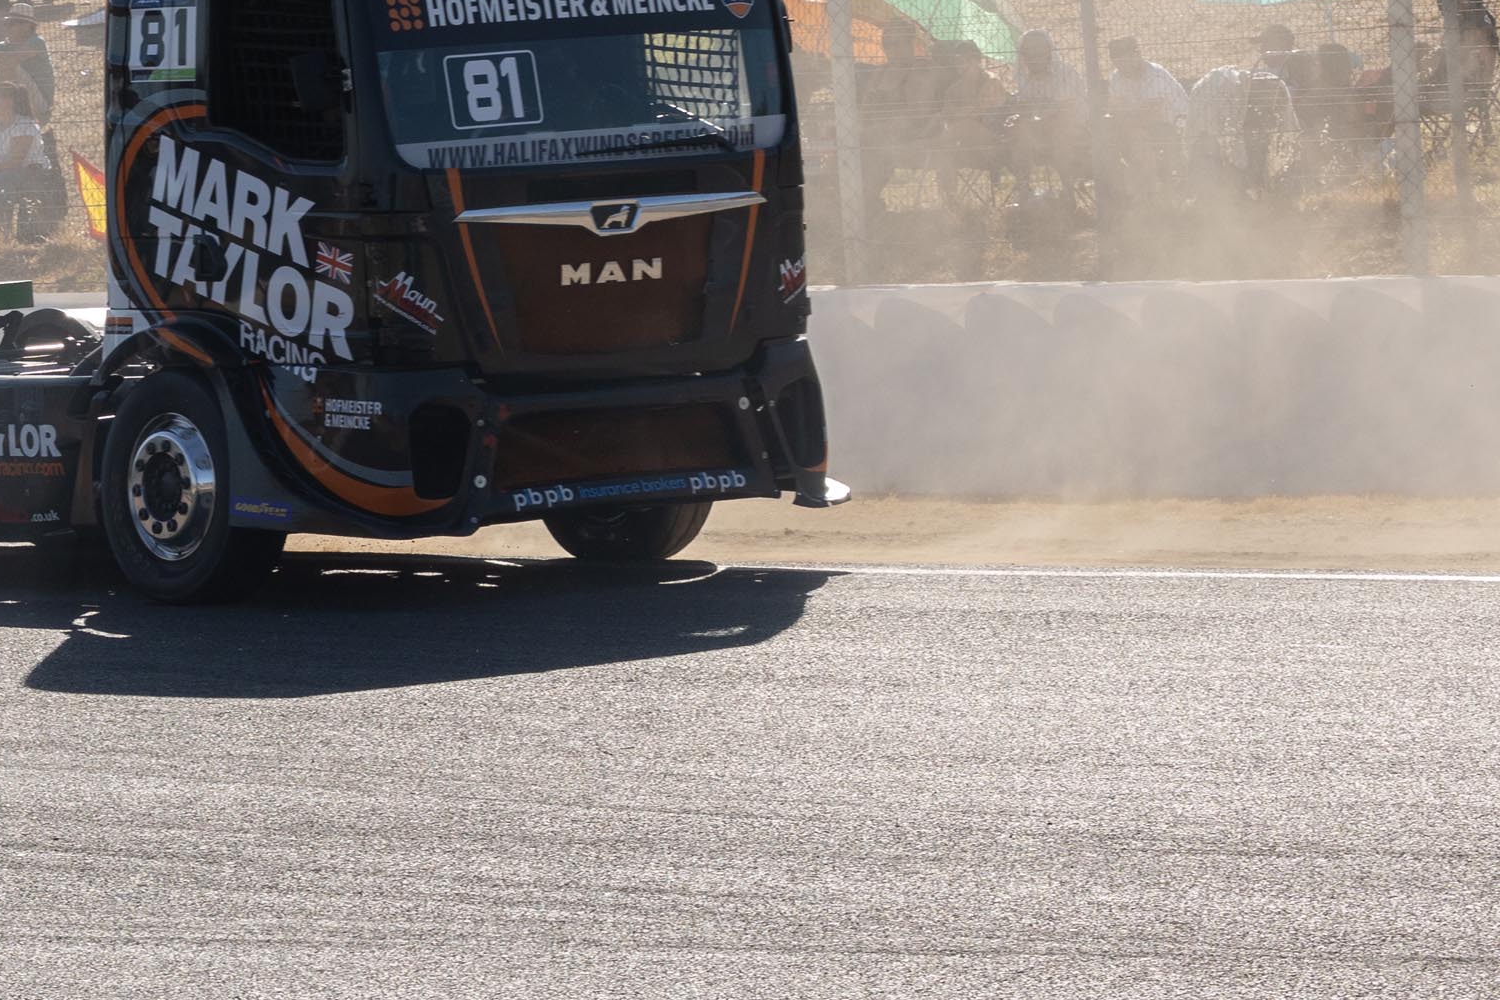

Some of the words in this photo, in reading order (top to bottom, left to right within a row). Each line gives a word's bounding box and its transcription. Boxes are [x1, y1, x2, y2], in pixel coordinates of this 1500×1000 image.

[139, 8, 188, 67] 81
[463, 56, 526, 122] 81
[152, 135, 315, 268] MARK
[148, 205, 355, 361] TAYLOR
[387, 272, 440, 317] Maun
[560, 257, 663, 287] MAN
[240, 319, 327, 383] RACING
[324, 398, 382, 415] HOFMEISTER
